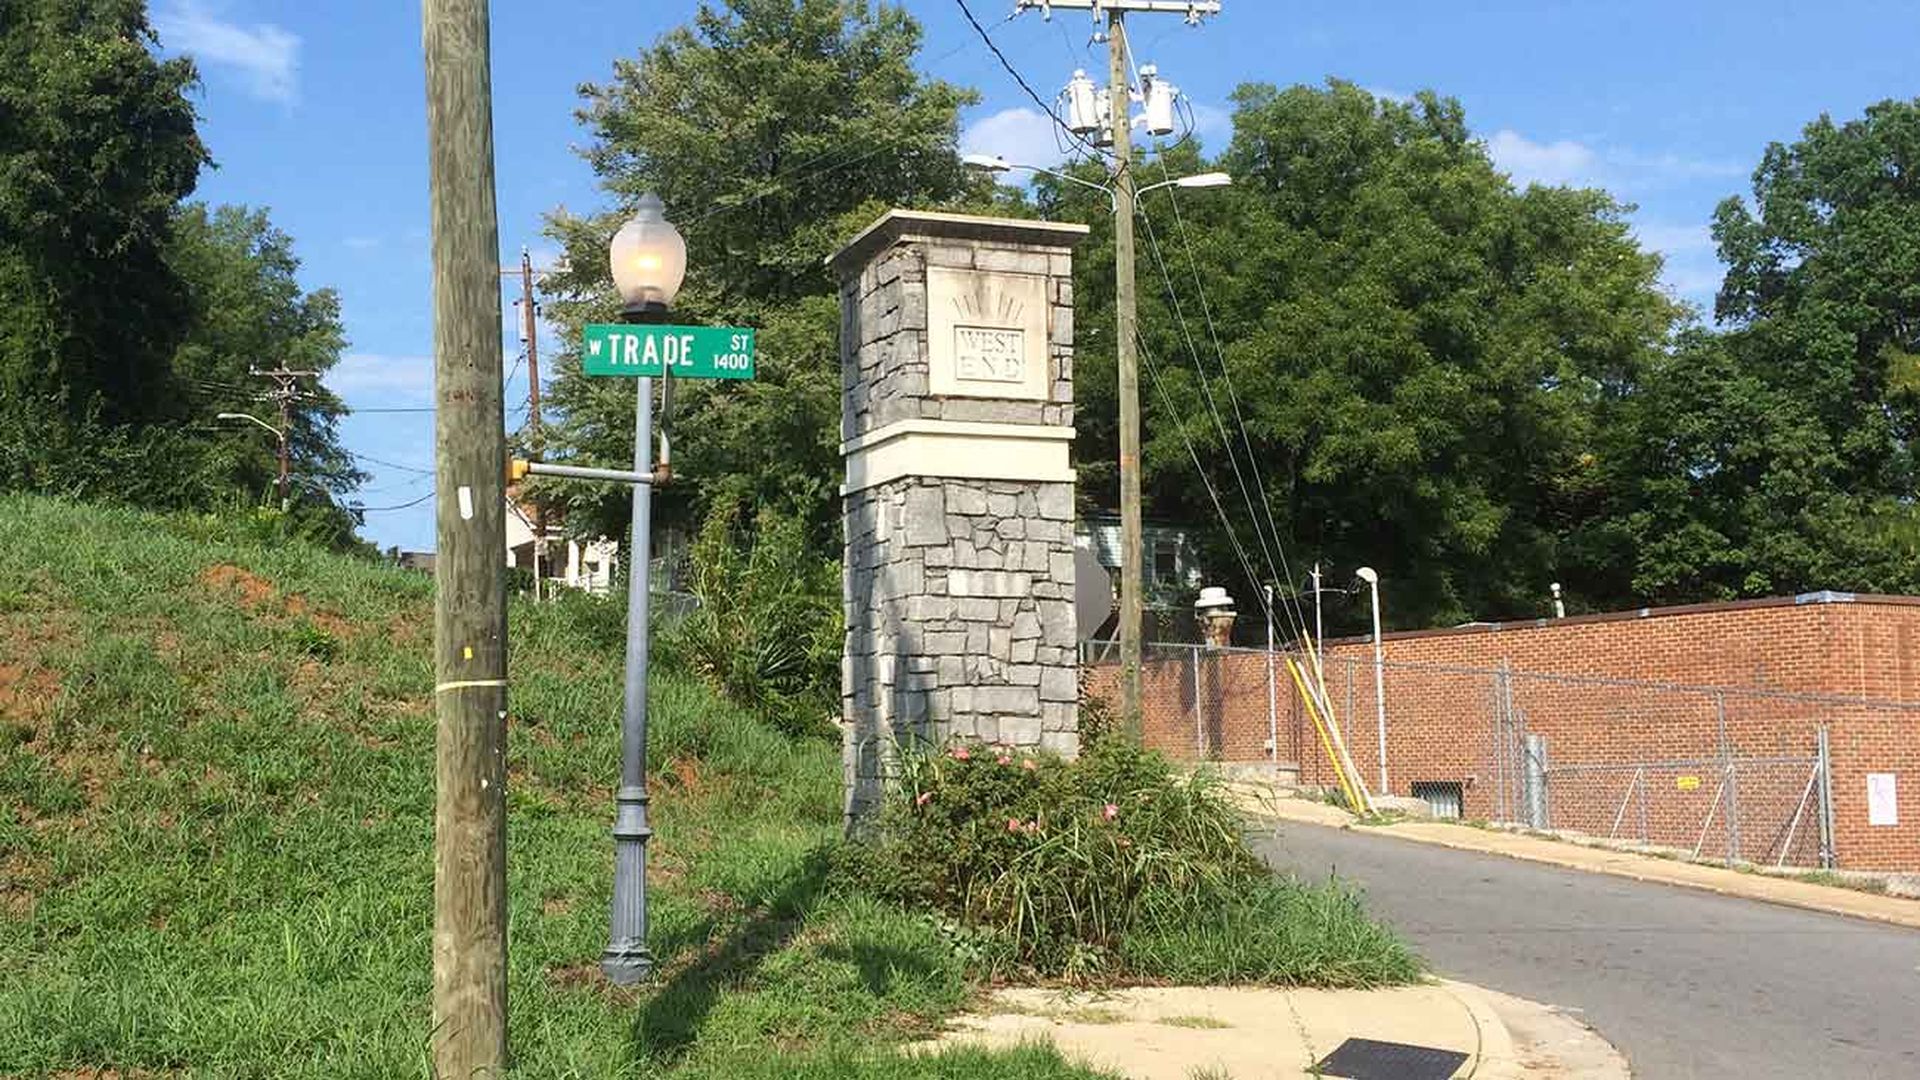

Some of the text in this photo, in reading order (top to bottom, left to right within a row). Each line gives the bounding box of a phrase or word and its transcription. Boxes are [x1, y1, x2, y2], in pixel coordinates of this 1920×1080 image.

[589, 334, 749, 366] W TRADE ST
[960, 330, 1019, 354] WEST
[713, 353, 748, 370] 1400
[960, 355, 1020, 378] END
